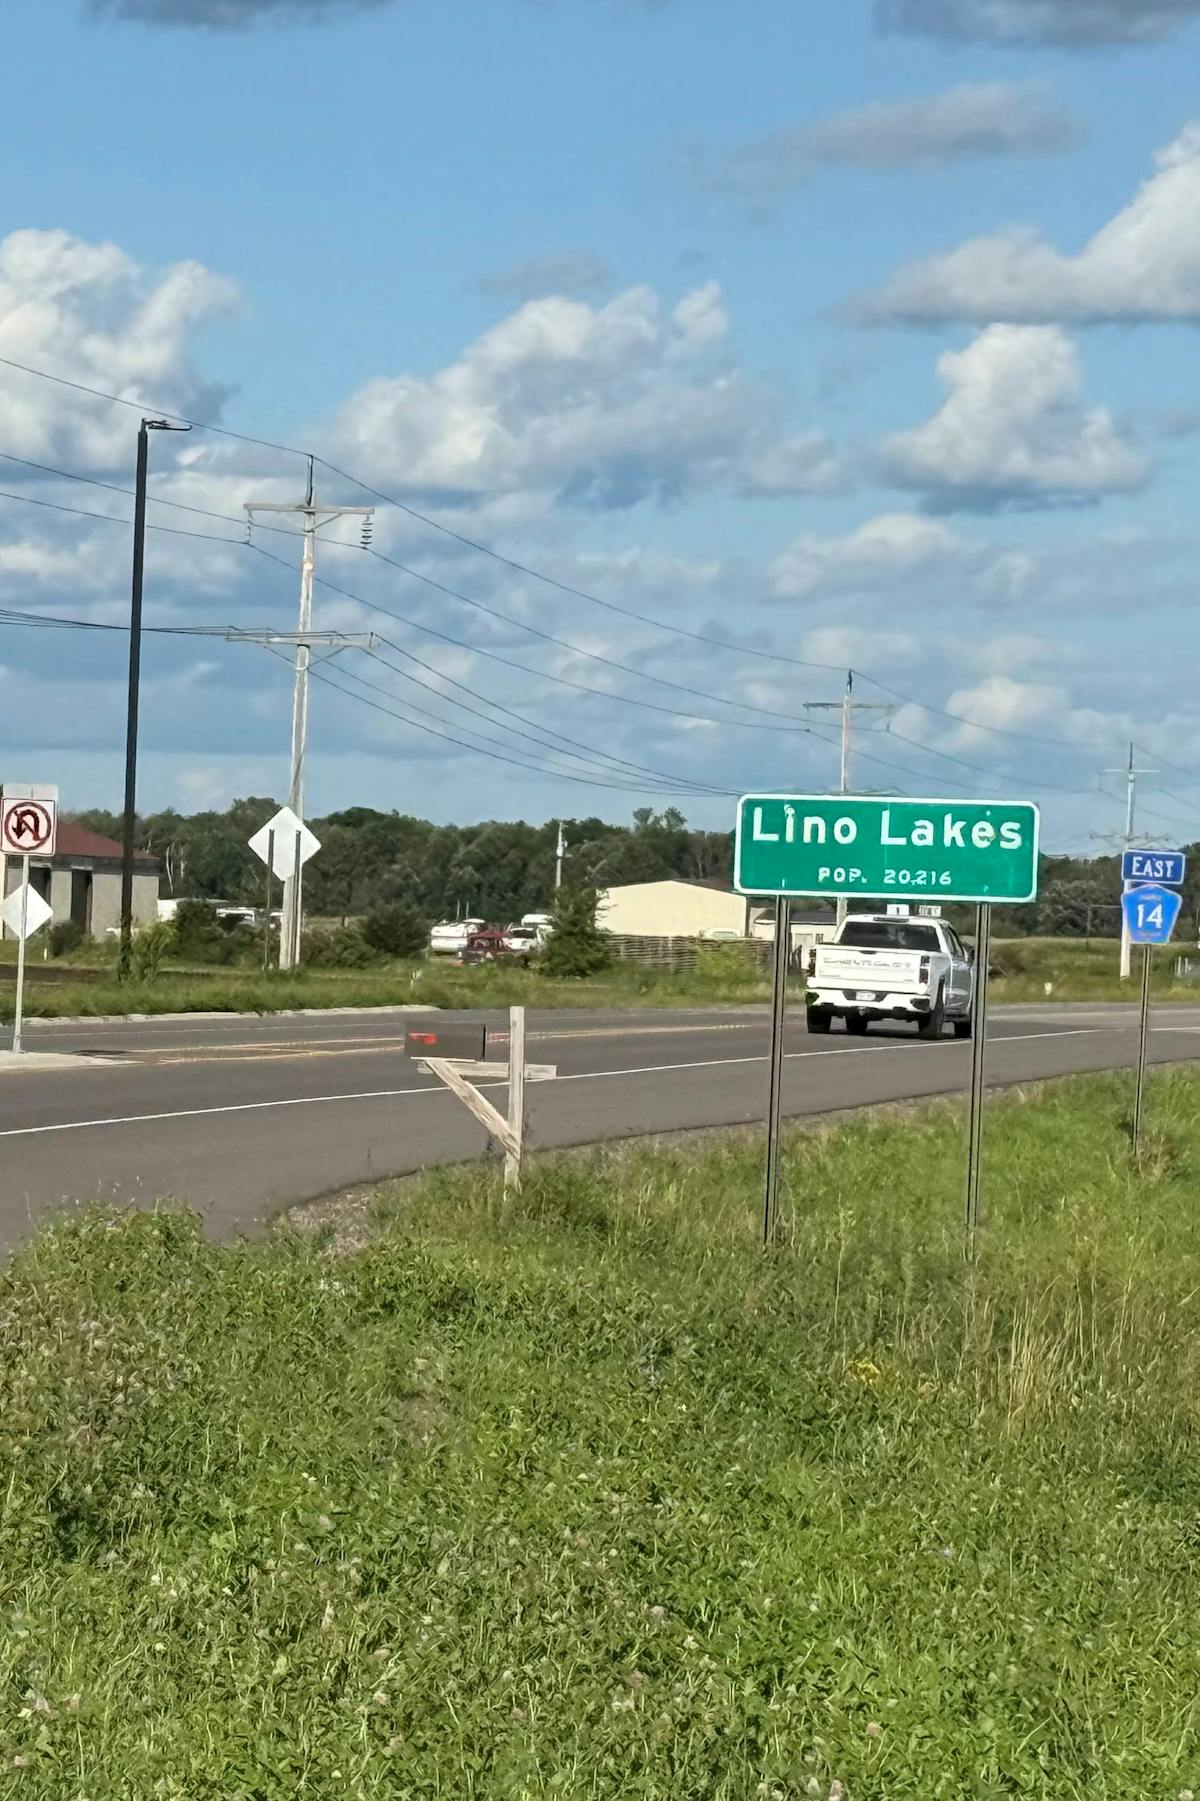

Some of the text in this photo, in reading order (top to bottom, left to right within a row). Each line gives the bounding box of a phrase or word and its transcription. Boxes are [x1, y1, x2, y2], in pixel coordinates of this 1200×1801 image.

[752, 804, 1022, 850] Lino Lakes
[817, 867, 868, 883] POP.
[1132, 856, 1174, 878] EAST
[1137, 904, 1163, 928] 14
